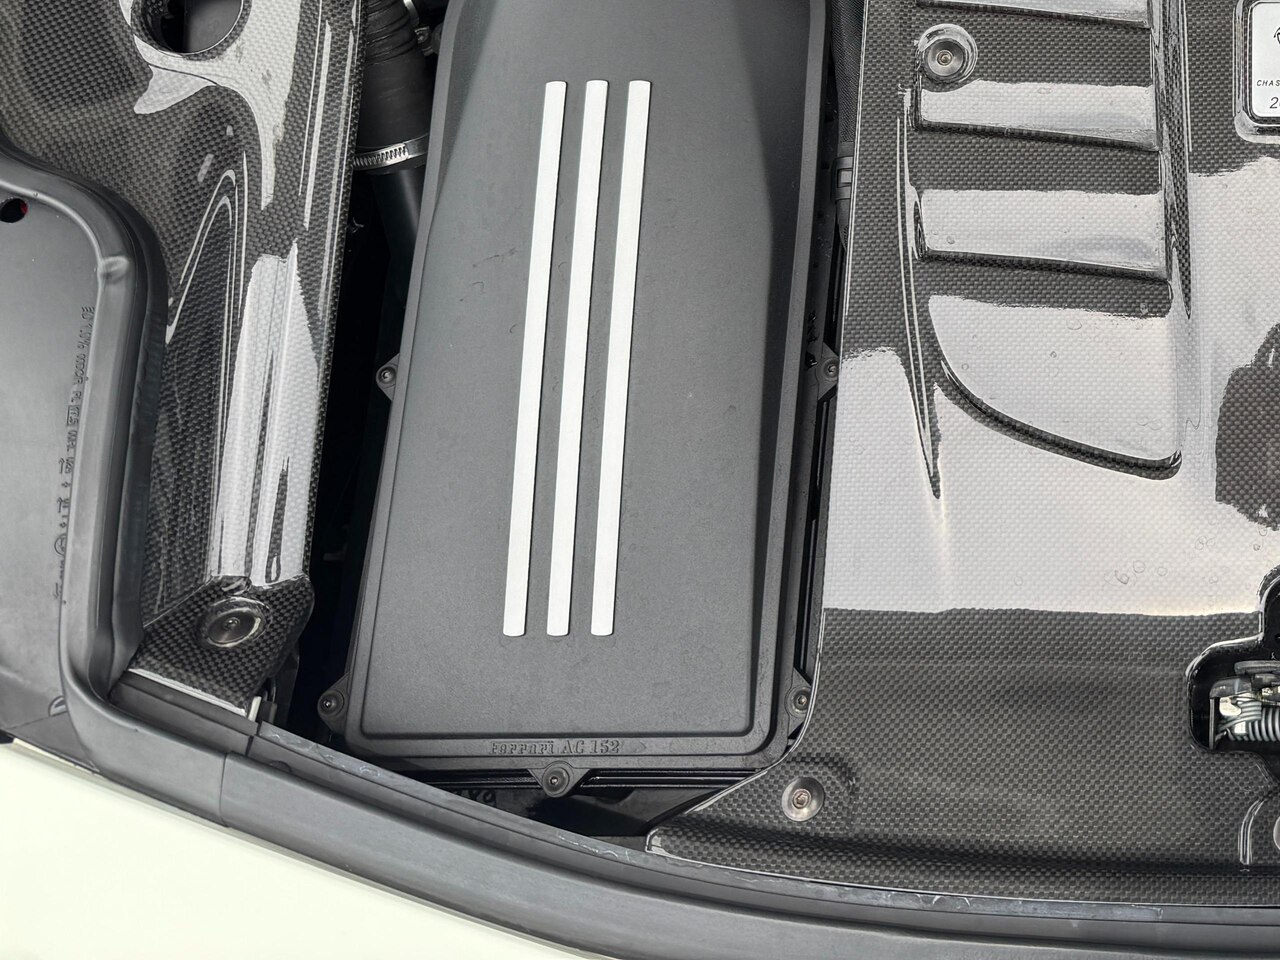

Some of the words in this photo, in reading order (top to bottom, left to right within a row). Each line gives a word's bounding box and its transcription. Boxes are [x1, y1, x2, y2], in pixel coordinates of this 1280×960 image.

[489, 740, 555, 754] Ferrari
[562, 739, 585, 754] AC
[592, 739, 620, 754] 152
